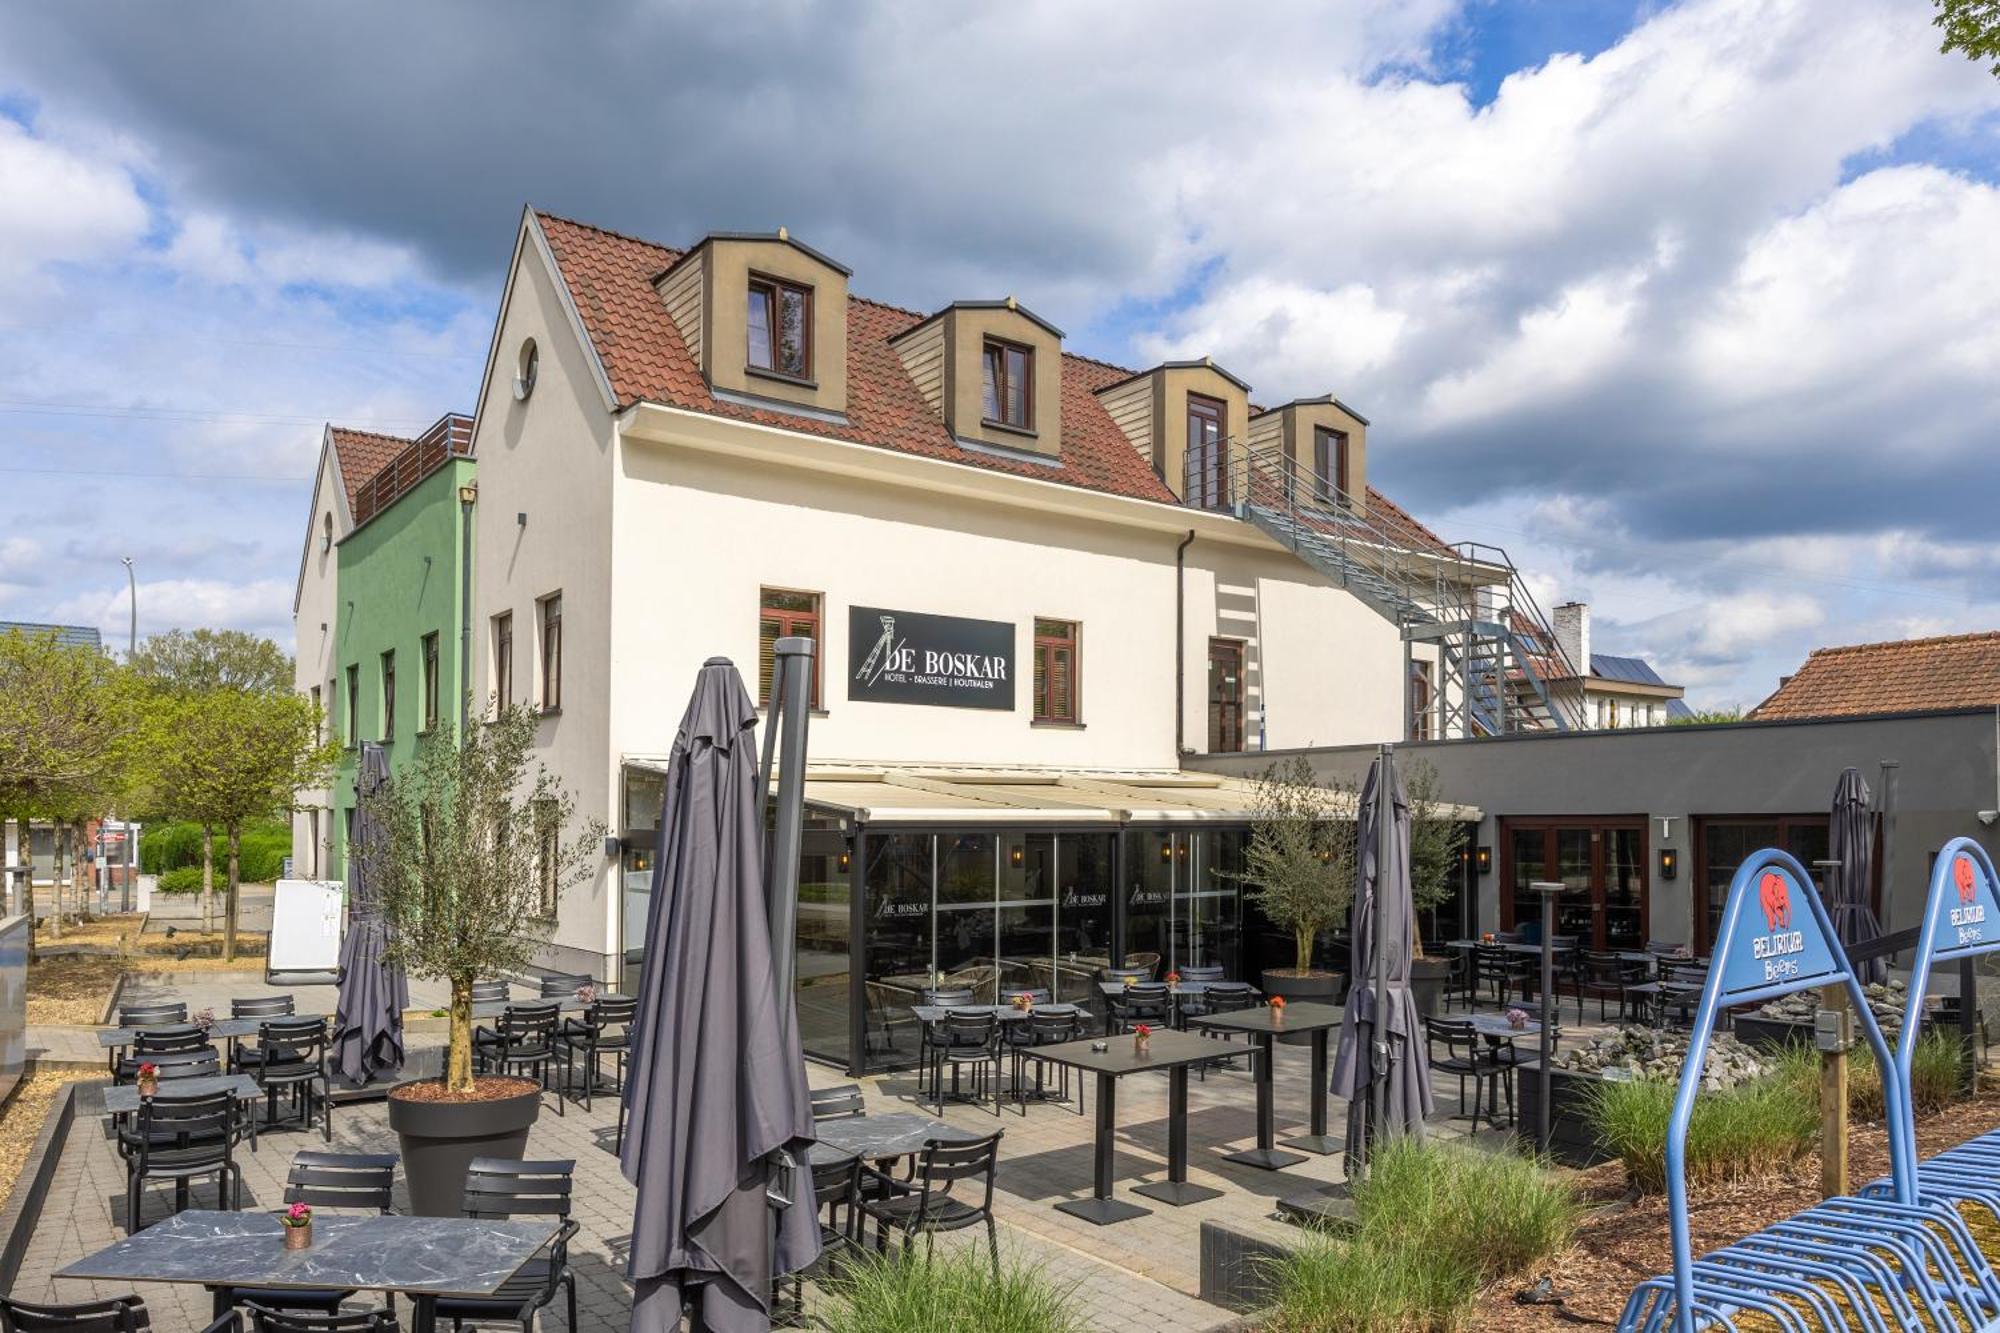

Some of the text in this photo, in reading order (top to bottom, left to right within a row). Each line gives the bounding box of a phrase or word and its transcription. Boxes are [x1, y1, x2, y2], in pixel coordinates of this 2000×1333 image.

[885, 648, 1007, 680] DE BOSKAR
[885, 672, 907, 684] HOTEL
[914, 675, 947, 686] BRASSERIE
[954, 678, 993, 689] HOUTHALEN
[898, 903, 928, 913] BOSKAR
[1950, 905, 1985, 926] DELIRIUM
[1753, 931, 1804, 959] DELIRIUM
